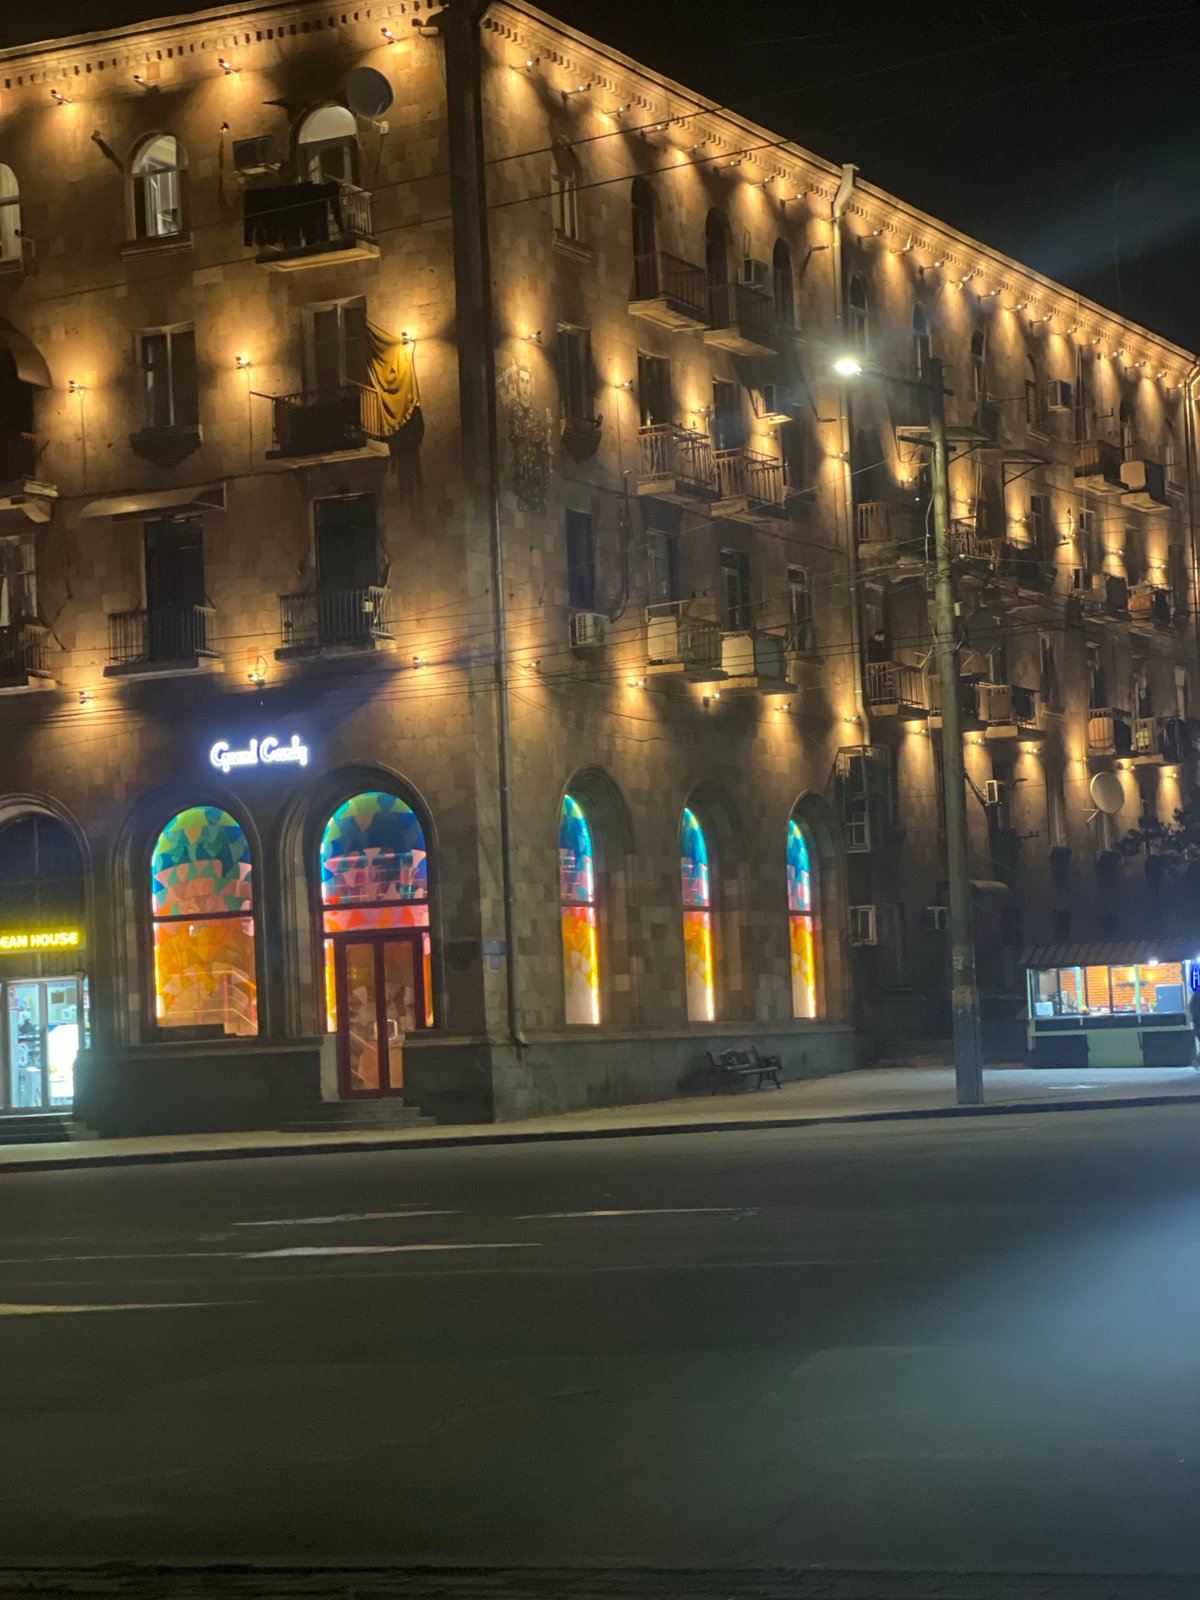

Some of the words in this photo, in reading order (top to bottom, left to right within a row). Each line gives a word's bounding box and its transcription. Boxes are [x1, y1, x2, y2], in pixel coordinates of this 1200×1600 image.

[259, 734, 308, 766] Candy
[0, 935, 28, 949] EAN
[30, 931, 79, 947] HOUSE
